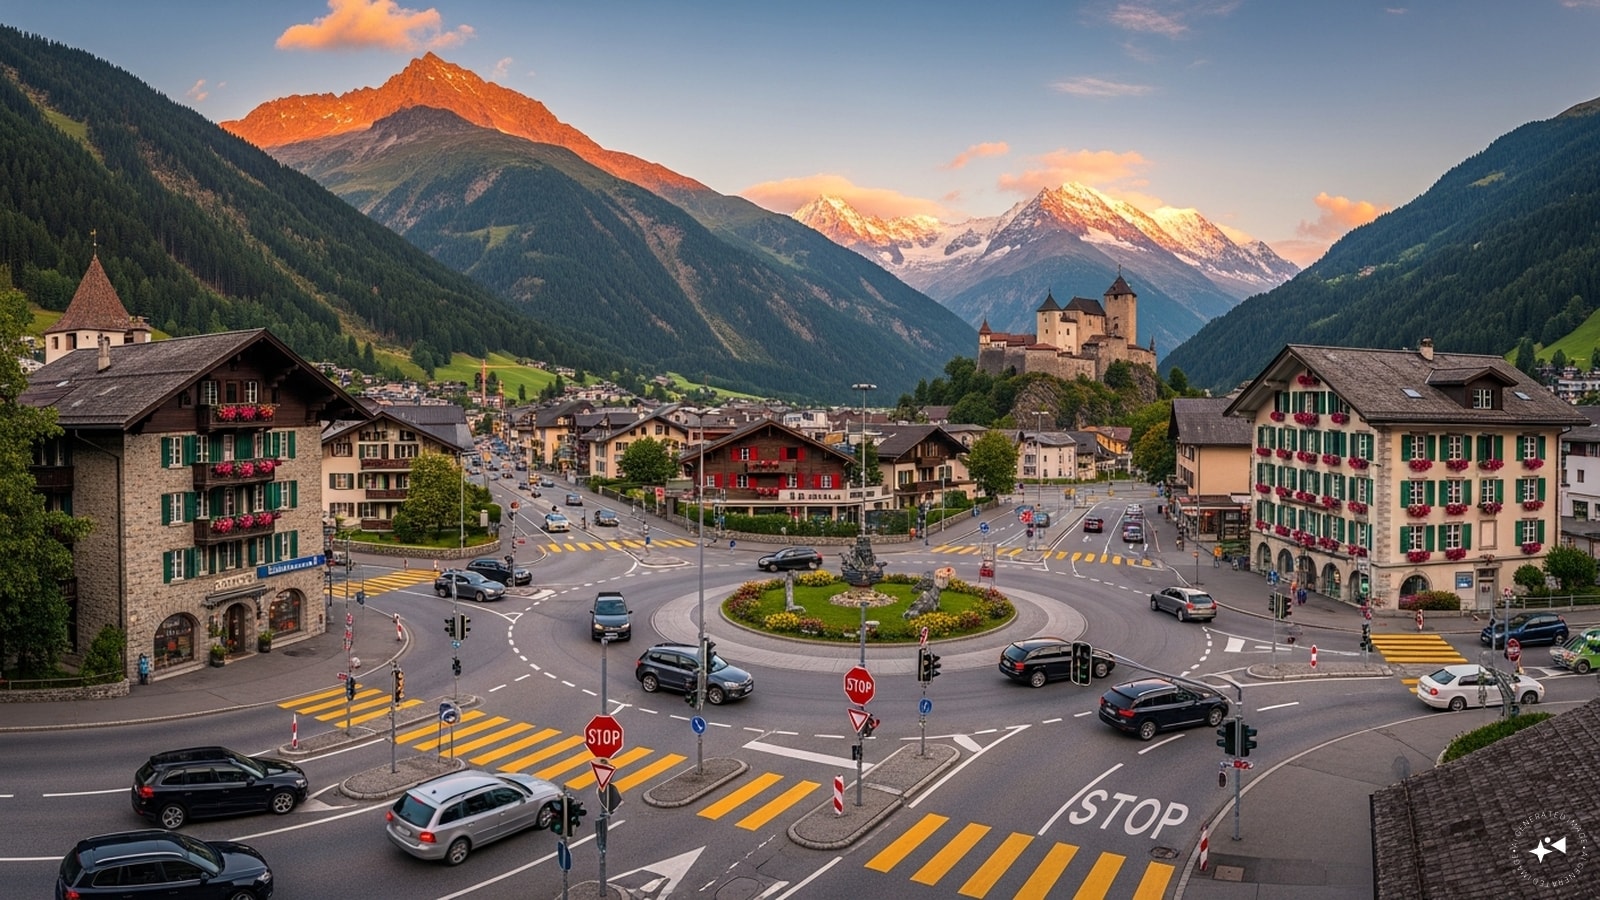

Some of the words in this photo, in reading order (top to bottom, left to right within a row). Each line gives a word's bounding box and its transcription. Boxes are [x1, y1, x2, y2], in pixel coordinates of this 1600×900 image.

[847, 678, 872, 693] STOP
[588, 729, 620, 745] STOP
[1069, 789, 1189, 839] STOP
